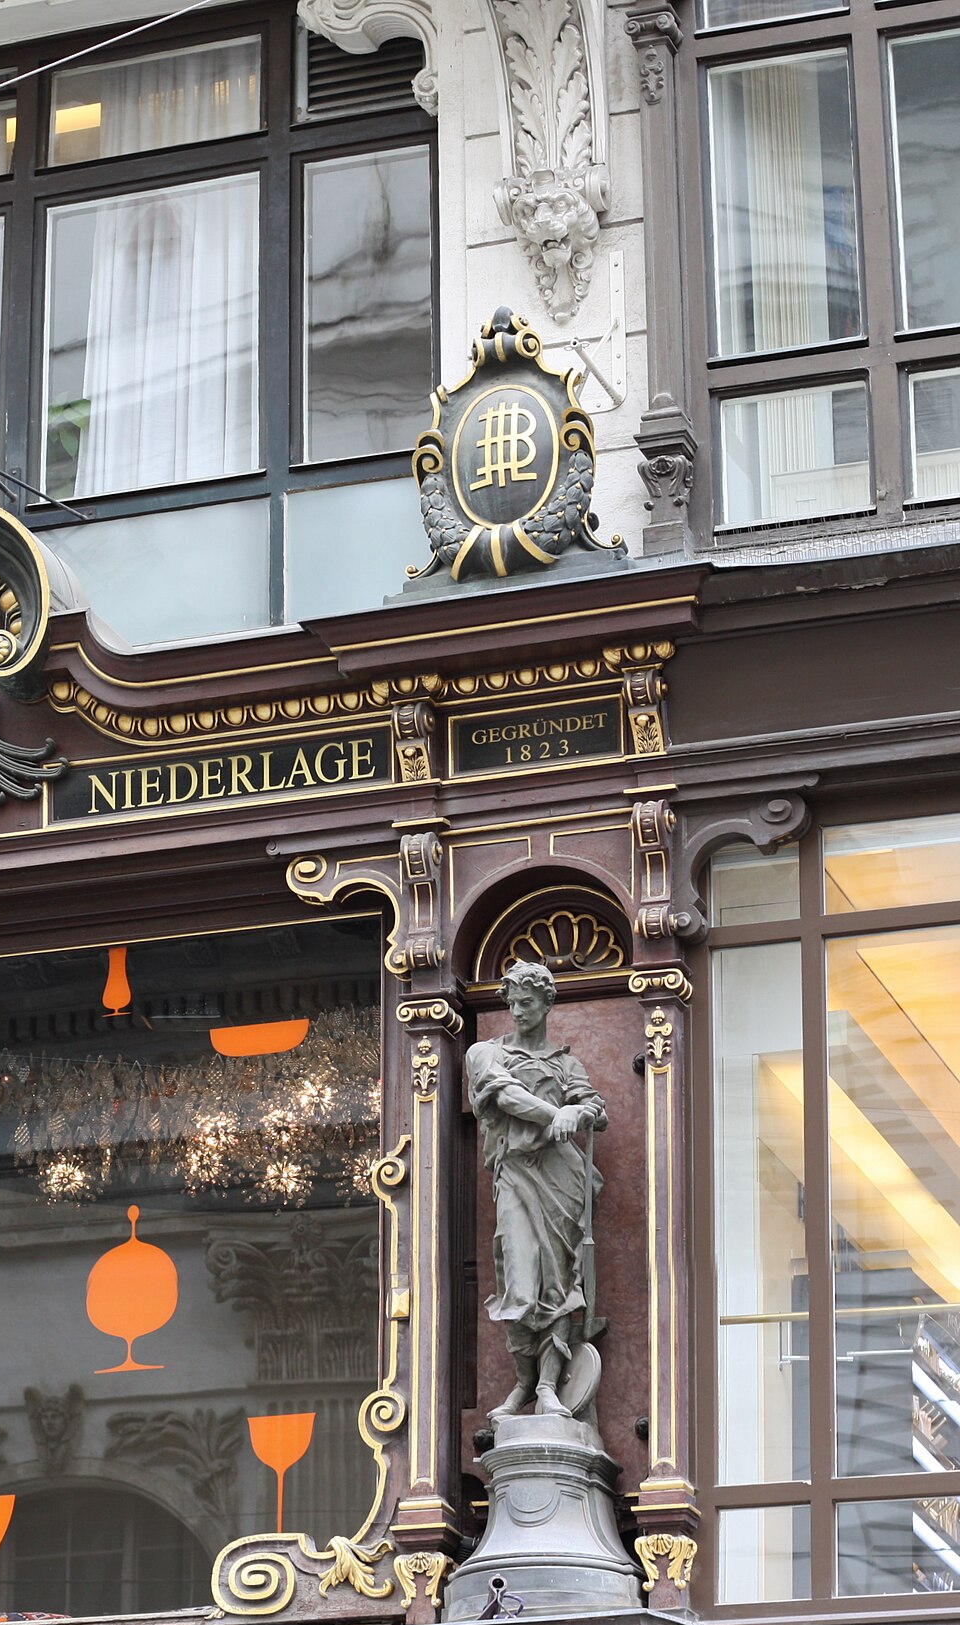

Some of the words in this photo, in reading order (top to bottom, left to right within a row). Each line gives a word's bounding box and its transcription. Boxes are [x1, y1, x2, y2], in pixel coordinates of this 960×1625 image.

[471, 712, 608, 745] GEGRÜNDET
[505, 739, 580, 763] 1823.
[87, 738, 376, 815] NIEDERLAGE
